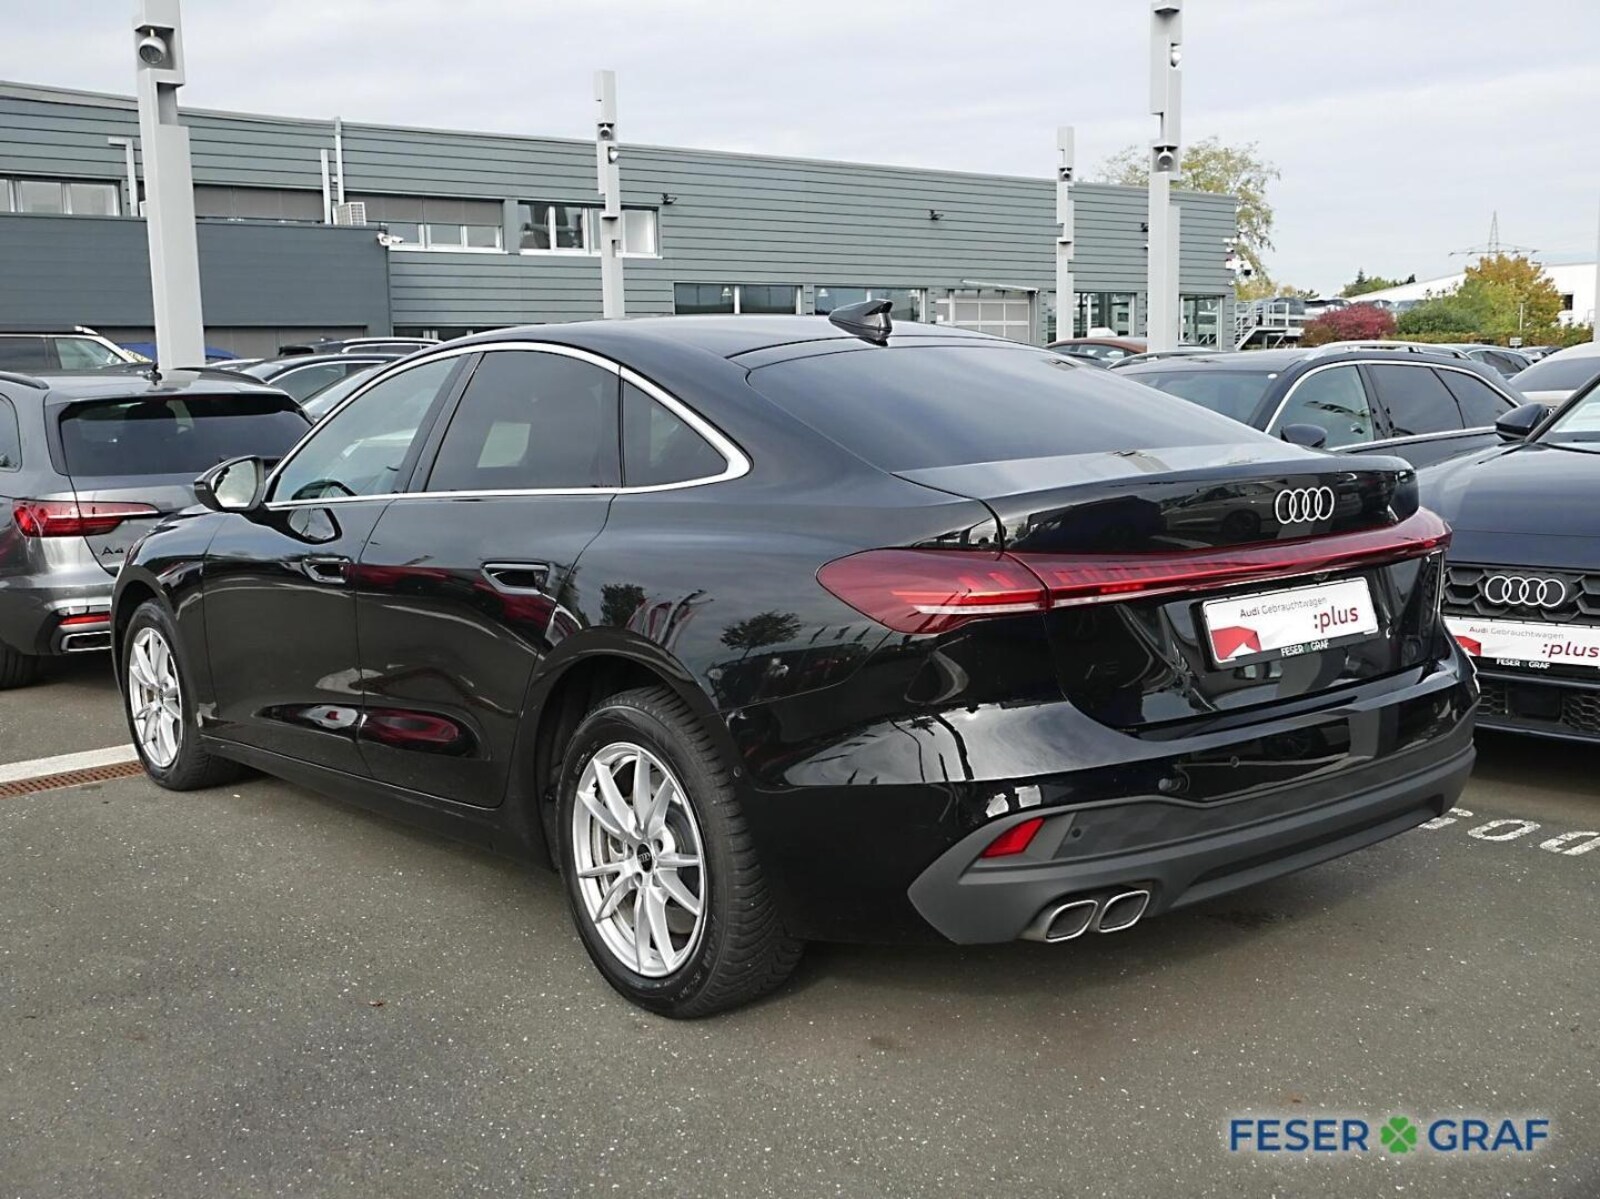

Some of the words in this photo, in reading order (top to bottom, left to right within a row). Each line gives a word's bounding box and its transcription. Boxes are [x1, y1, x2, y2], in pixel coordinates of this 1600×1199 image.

[101, 546, 124, 556] A4
[1239, 606, 1260, 618] Audi
[1261, 596, 1328, 615] Gebrauchtwagen
[1313, 605, 1359, 633] :plus
[1469, 626, 1488, 634] Audi
[1490, 628, 1564, 640] Gebrauchtwagen
[1280, 646, 1304, 657] FESER
[1310, 638, 1329, 651] GRAF
[1541, 641, 1599, 658] :plus
[1496, 657, 1521, 667] FESER
[1528, 661, 1550, 669] GRAF
